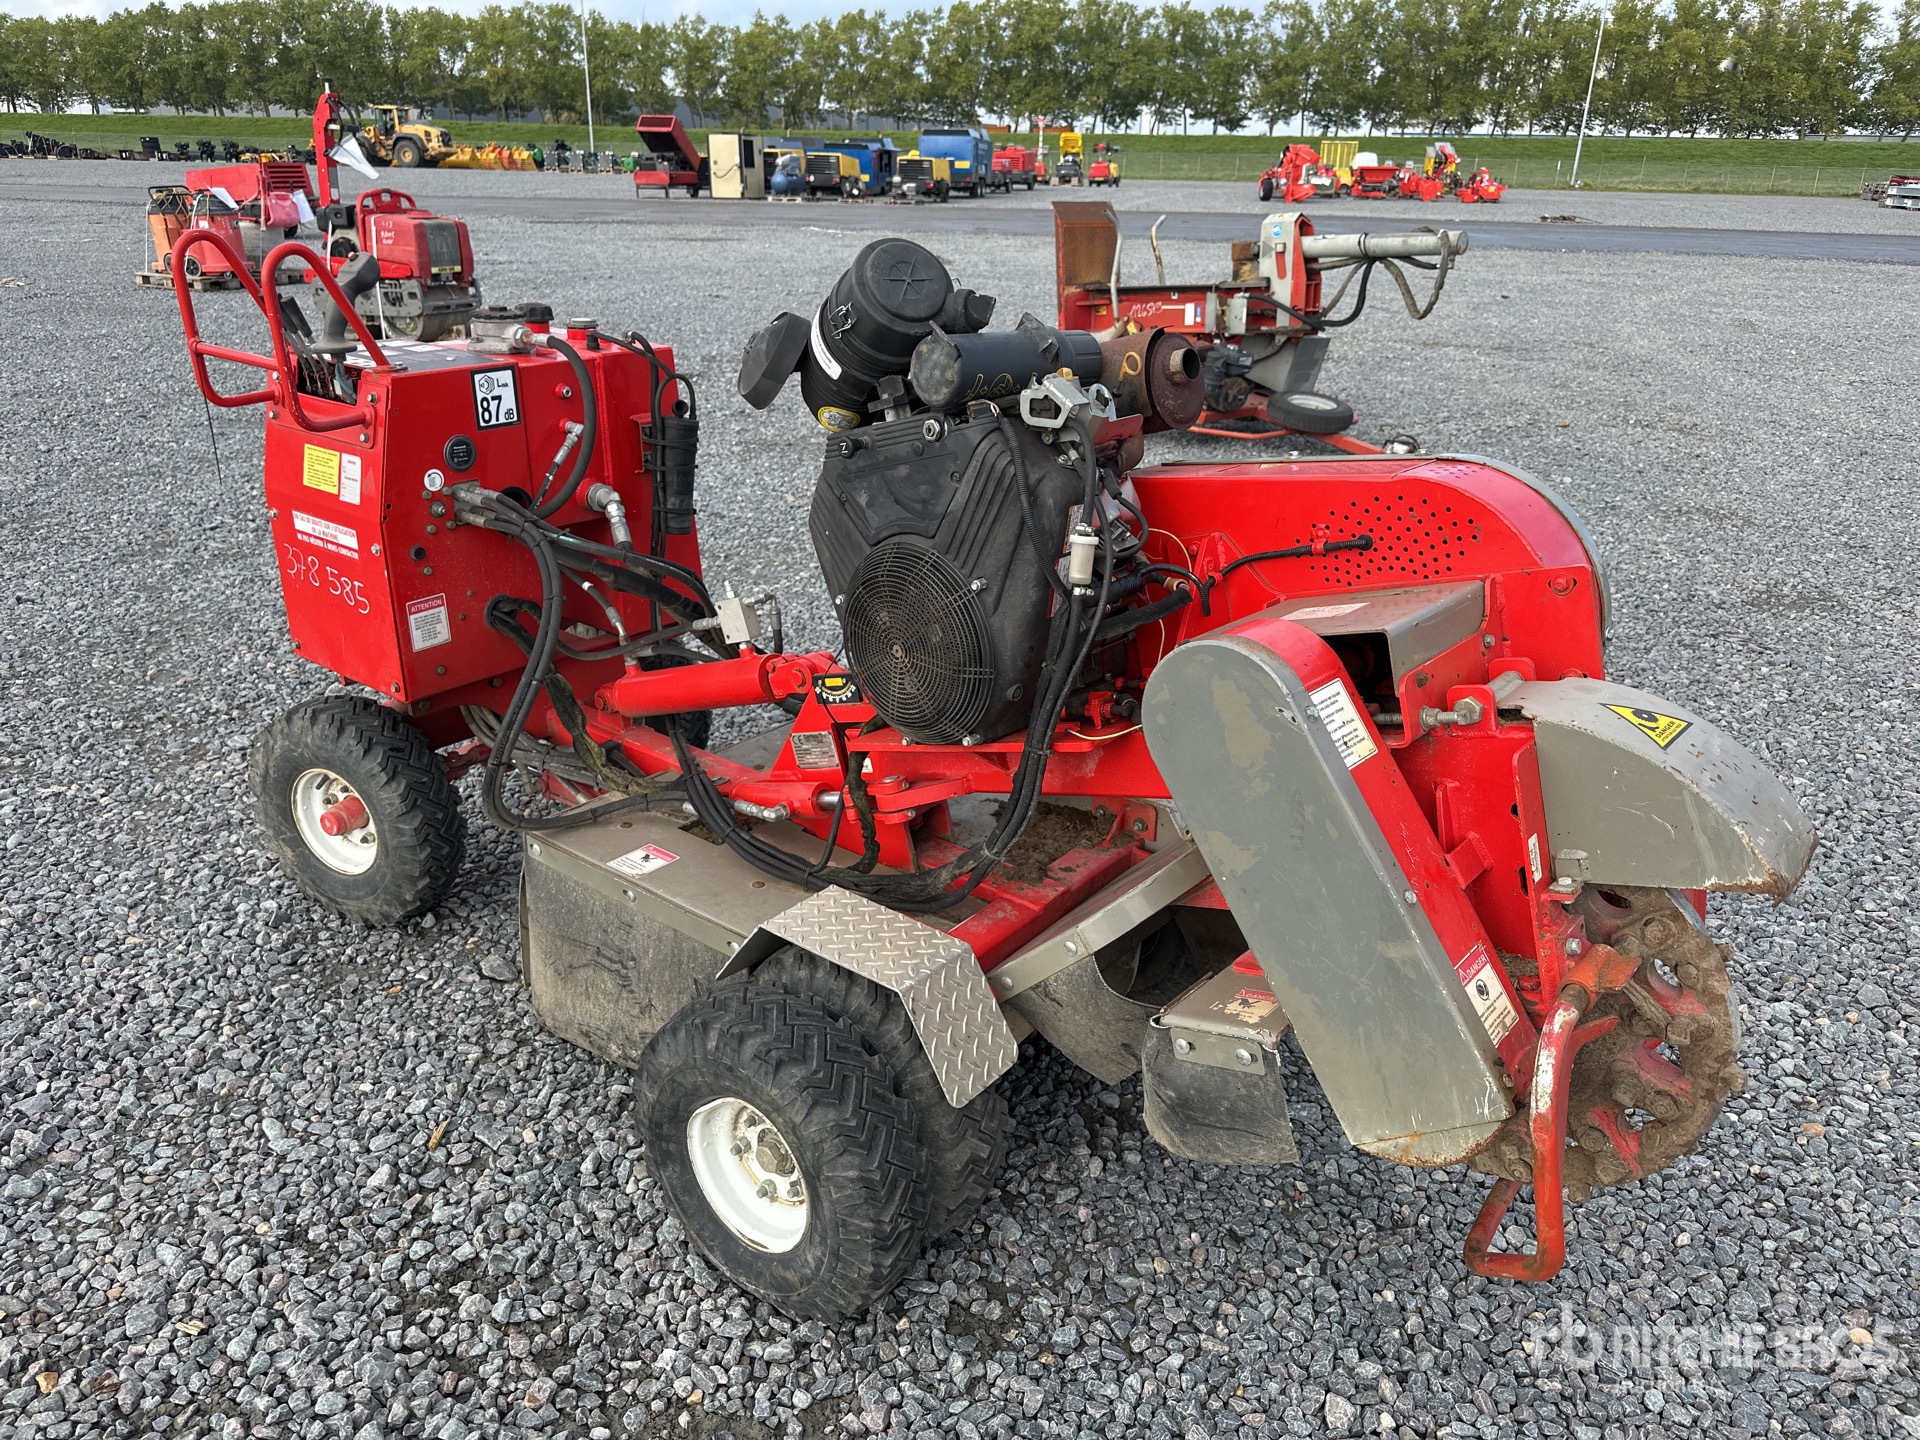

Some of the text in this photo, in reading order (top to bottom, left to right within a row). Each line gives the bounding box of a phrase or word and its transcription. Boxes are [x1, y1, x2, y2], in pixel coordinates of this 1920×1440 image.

[480, 394, 515, 425] 87 dB
[283, 543, 371, 615] 378 585
[411, 598, 442, 613] ATTENTION
[1655, 720, 1676, 738] DANGER
[1466, 954, 1488, 979] DANGER
